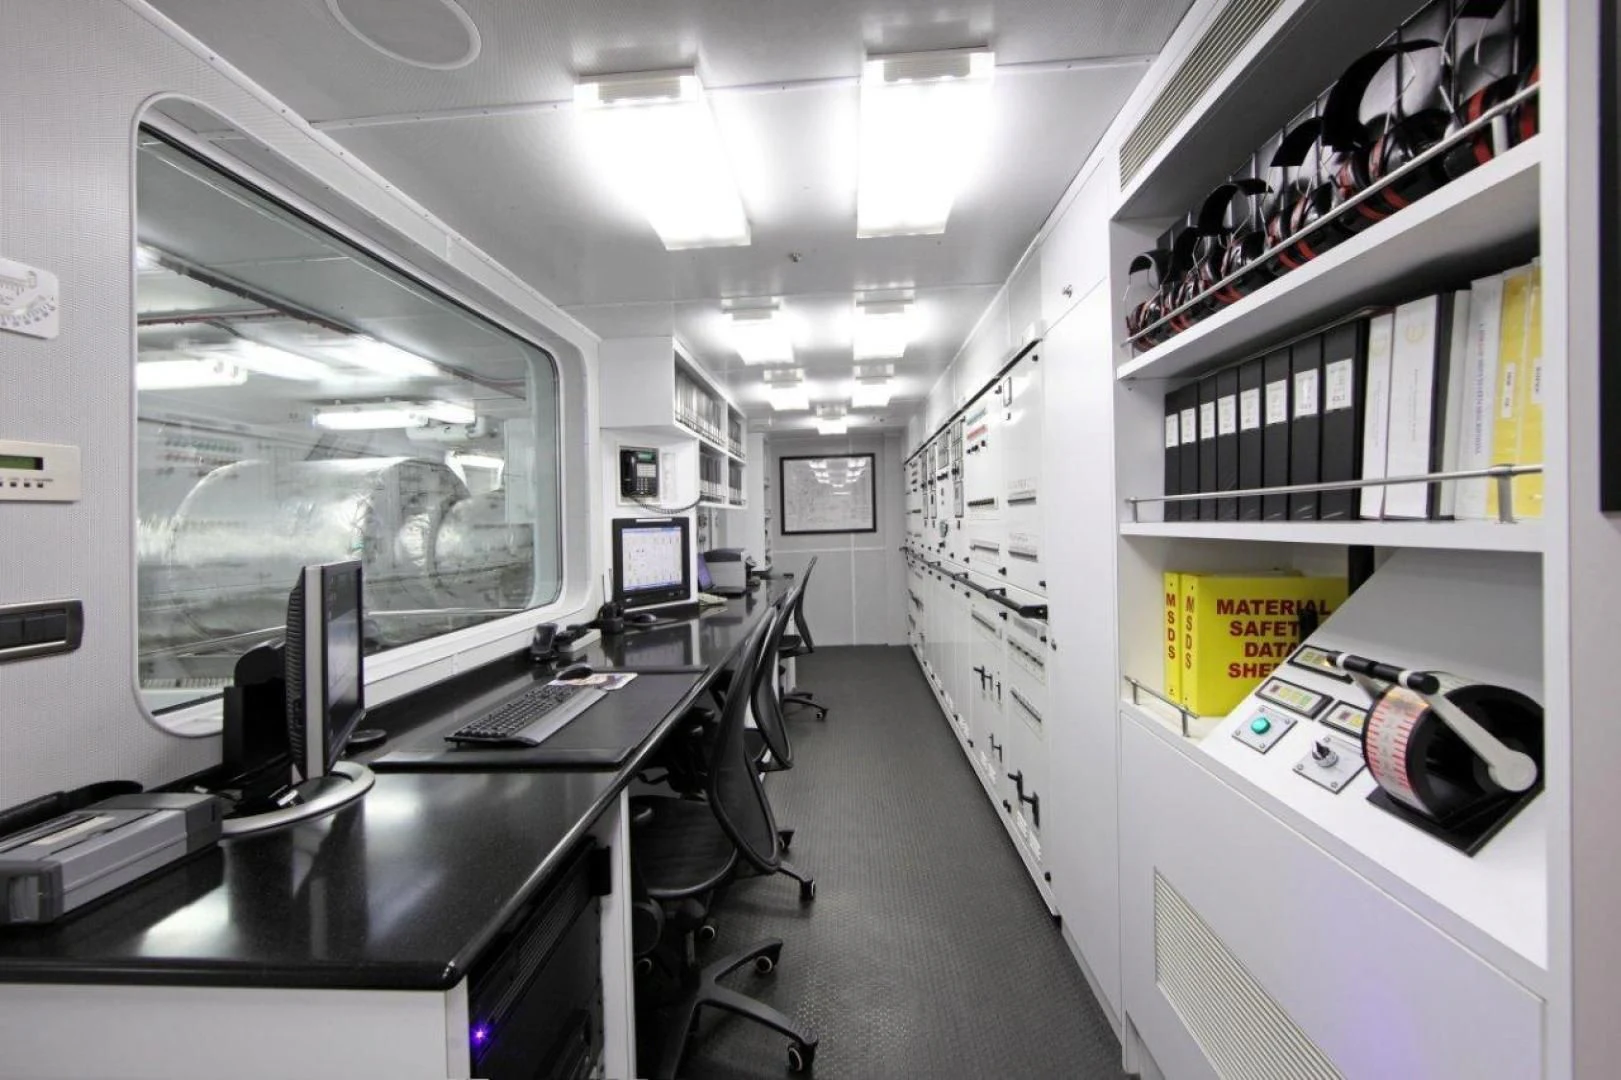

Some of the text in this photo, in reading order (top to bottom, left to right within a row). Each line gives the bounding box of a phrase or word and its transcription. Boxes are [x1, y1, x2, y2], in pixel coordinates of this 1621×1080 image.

[1216, 599, 1332, 616] MATERIAL
[1165, 593, 1176, 660] MSDS
[1184, 595, 1195, 670] MSDS
[1230, 620, 1300, 637] SAFET
[1228, 662, 1279, 678] SHE
